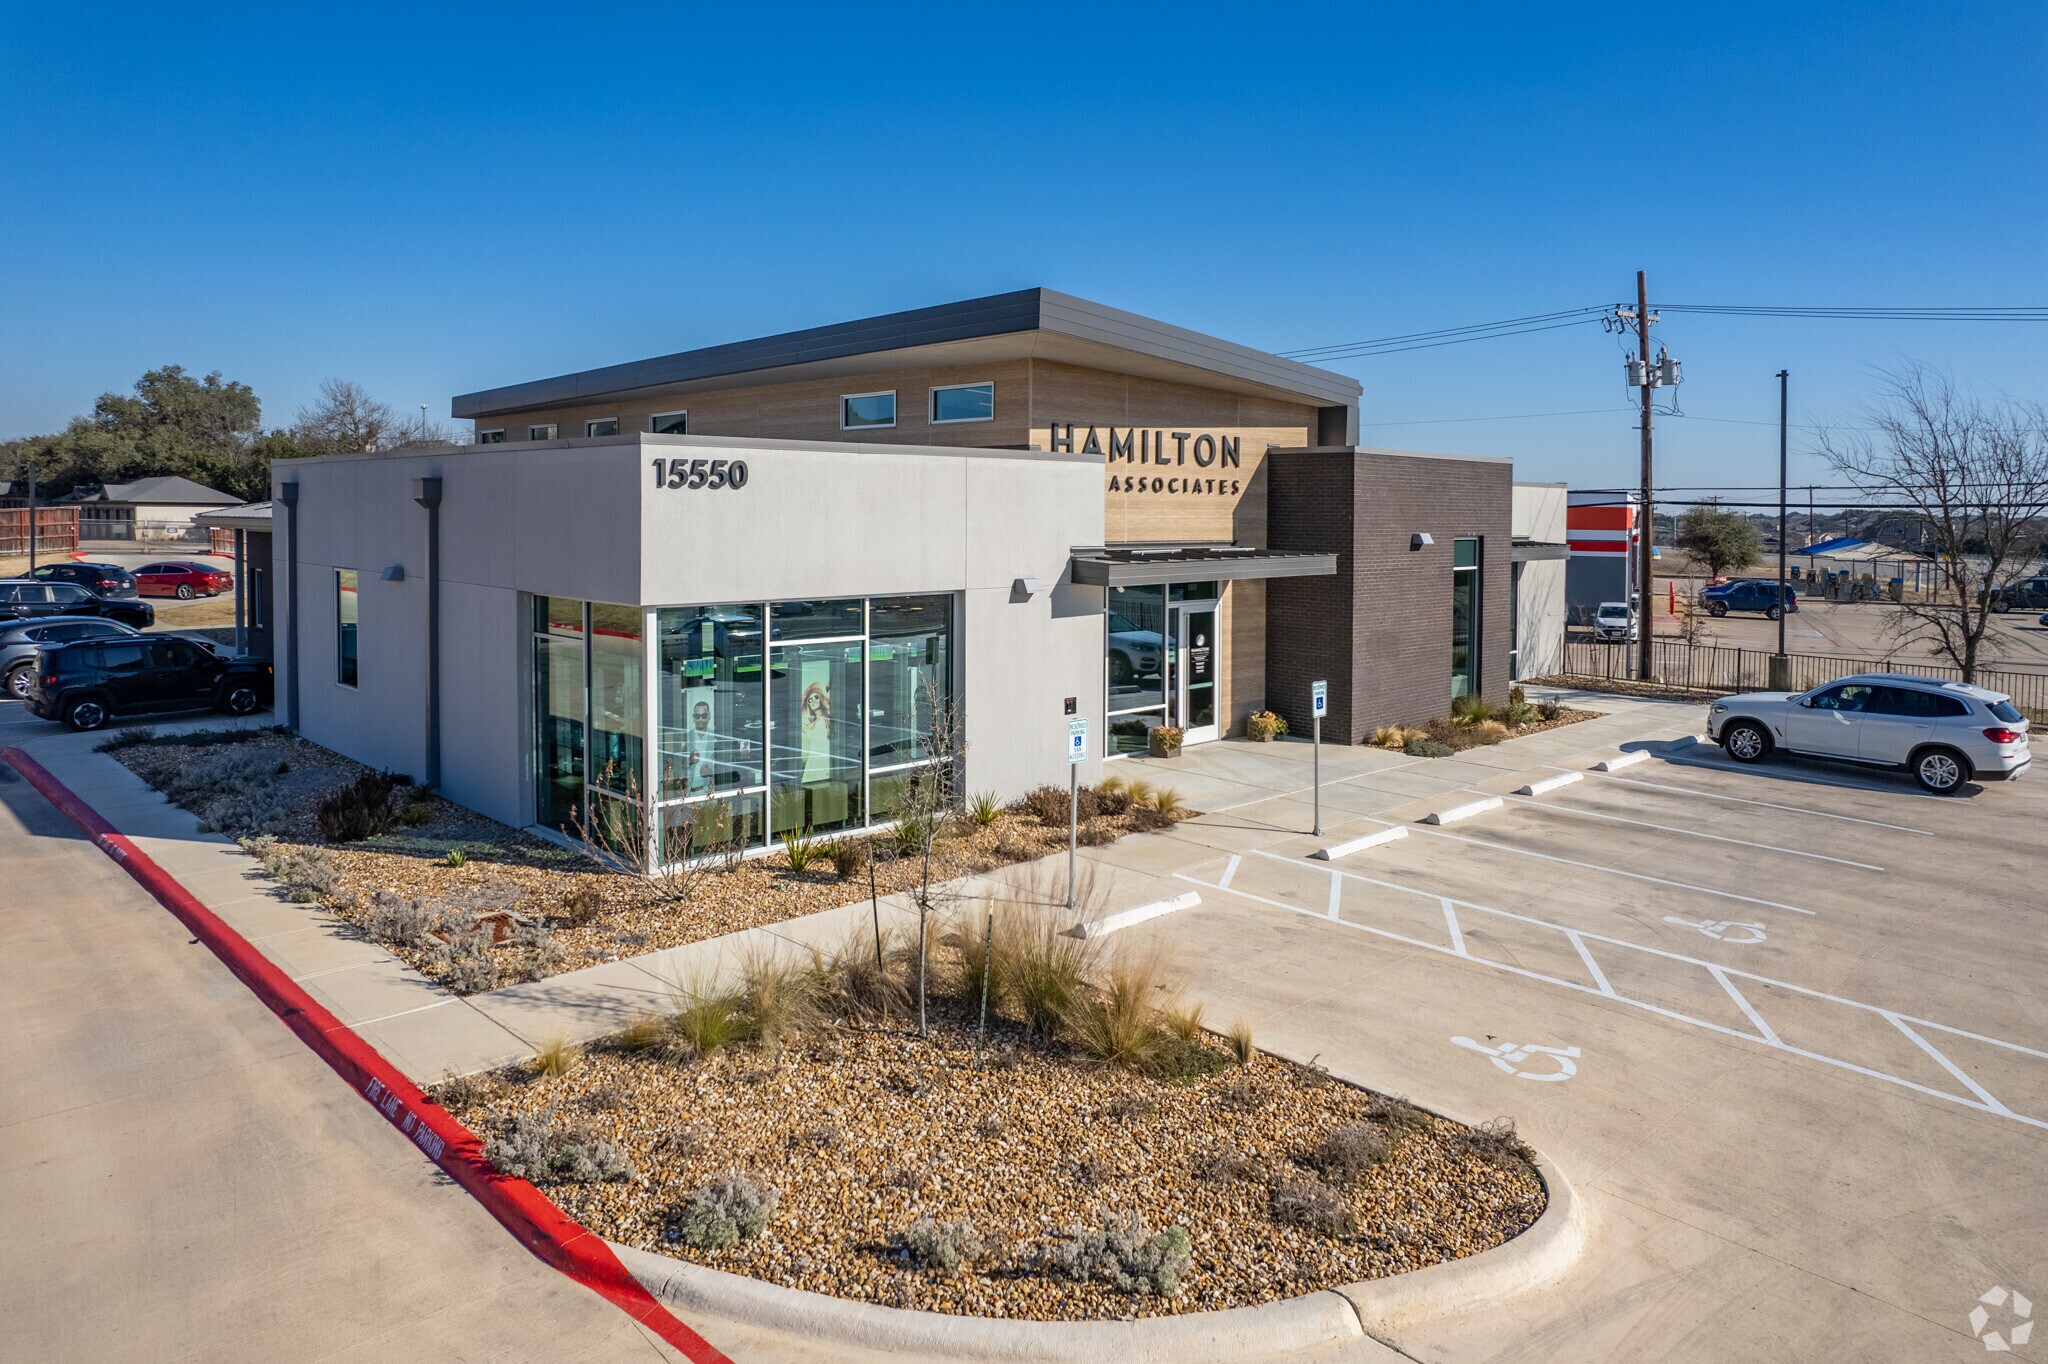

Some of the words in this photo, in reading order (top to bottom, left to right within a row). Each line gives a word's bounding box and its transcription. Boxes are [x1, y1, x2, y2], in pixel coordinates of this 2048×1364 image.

[1050, 422, 1241, 469] HAMILTON
[651, 458, 749, 490] 15550
[1108, 475, 1241, 496] ASSOCIATES
[380, 1090, 403, 1119] LANE
[401, 1110, 417, 1132] NO
[413, 1121, 446, 1160] PARKING
